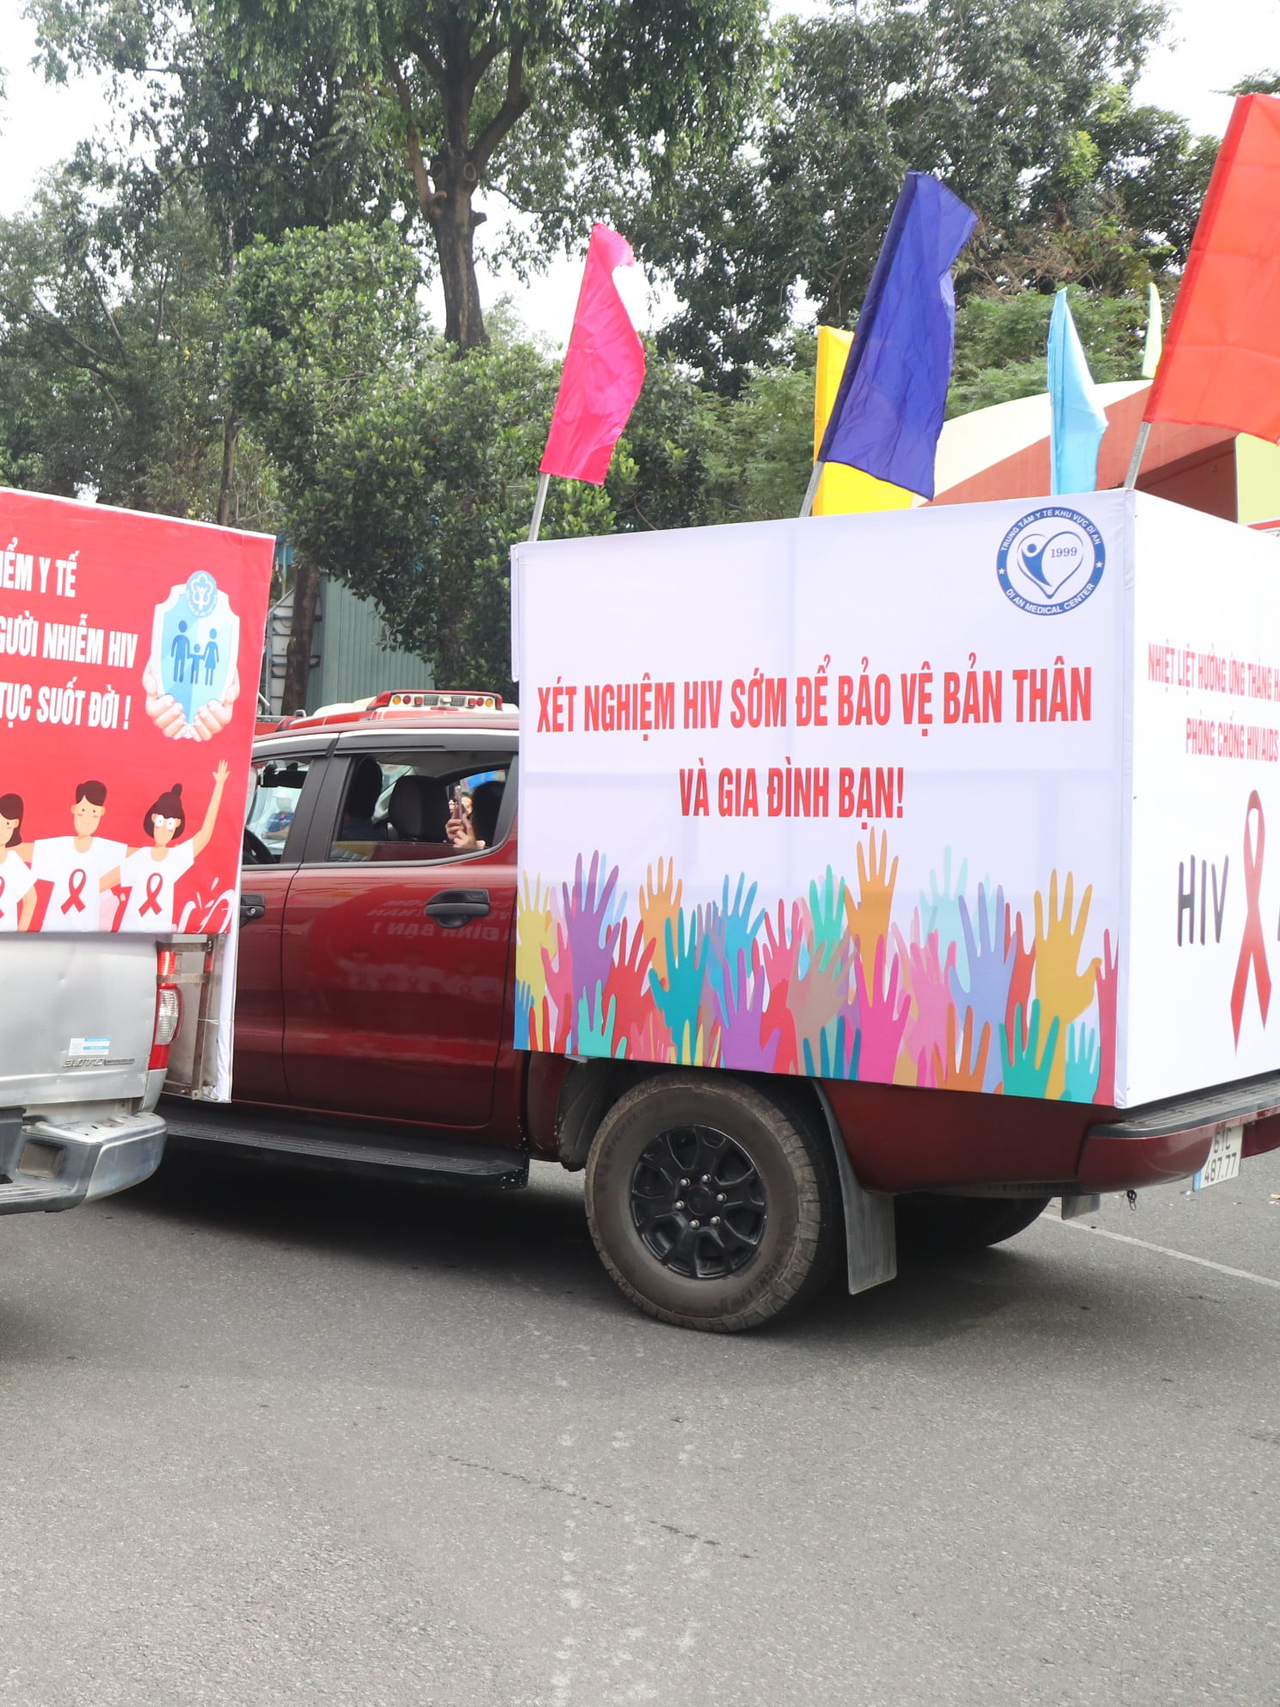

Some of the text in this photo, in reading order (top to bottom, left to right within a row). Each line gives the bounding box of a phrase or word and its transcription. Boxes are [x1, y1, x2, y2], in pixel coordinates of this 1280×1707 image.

[1001, 526, 1020, 552] TRUNG
[1034, 511, 1041, 520] Y
[1054, 508, 1073, 519] KHU
[1073, 514, 1089, 528] VỰC
[1091, 532, 1102, 546] AN
[1050, 546, 1078, 559] 1999
[39, 556, 51, 594] Y
[55, 550, 80, 598] TẾ
[1005, 582, 1096, 615] DI AN MEDICAL CENTER
[42, 613, 105, 666] NHIỄM
[107, 630, 138, 669] HIV
[1148, 638, 1176, 693] NHIỆT
[1178, 643, 1195, 696] LIỆT
[36, 677, 86, 727] SUỐT
[88, 684, 120, 729] ĐỜI
[123, 695, 132, 730] !
[537, 652, 1092, 741] XÉT NGHIỆM HIV SỚM ĐỂ BẢO VỆ BẢN THÂN
[1186, 709, 1279, 763] PHÒNG CHỐNG HIV/AIDS
[679, 756, 904, 830] VÀ GIA ĐÌNH BẠN!
[1177, 854, 1230, 947] HIV
